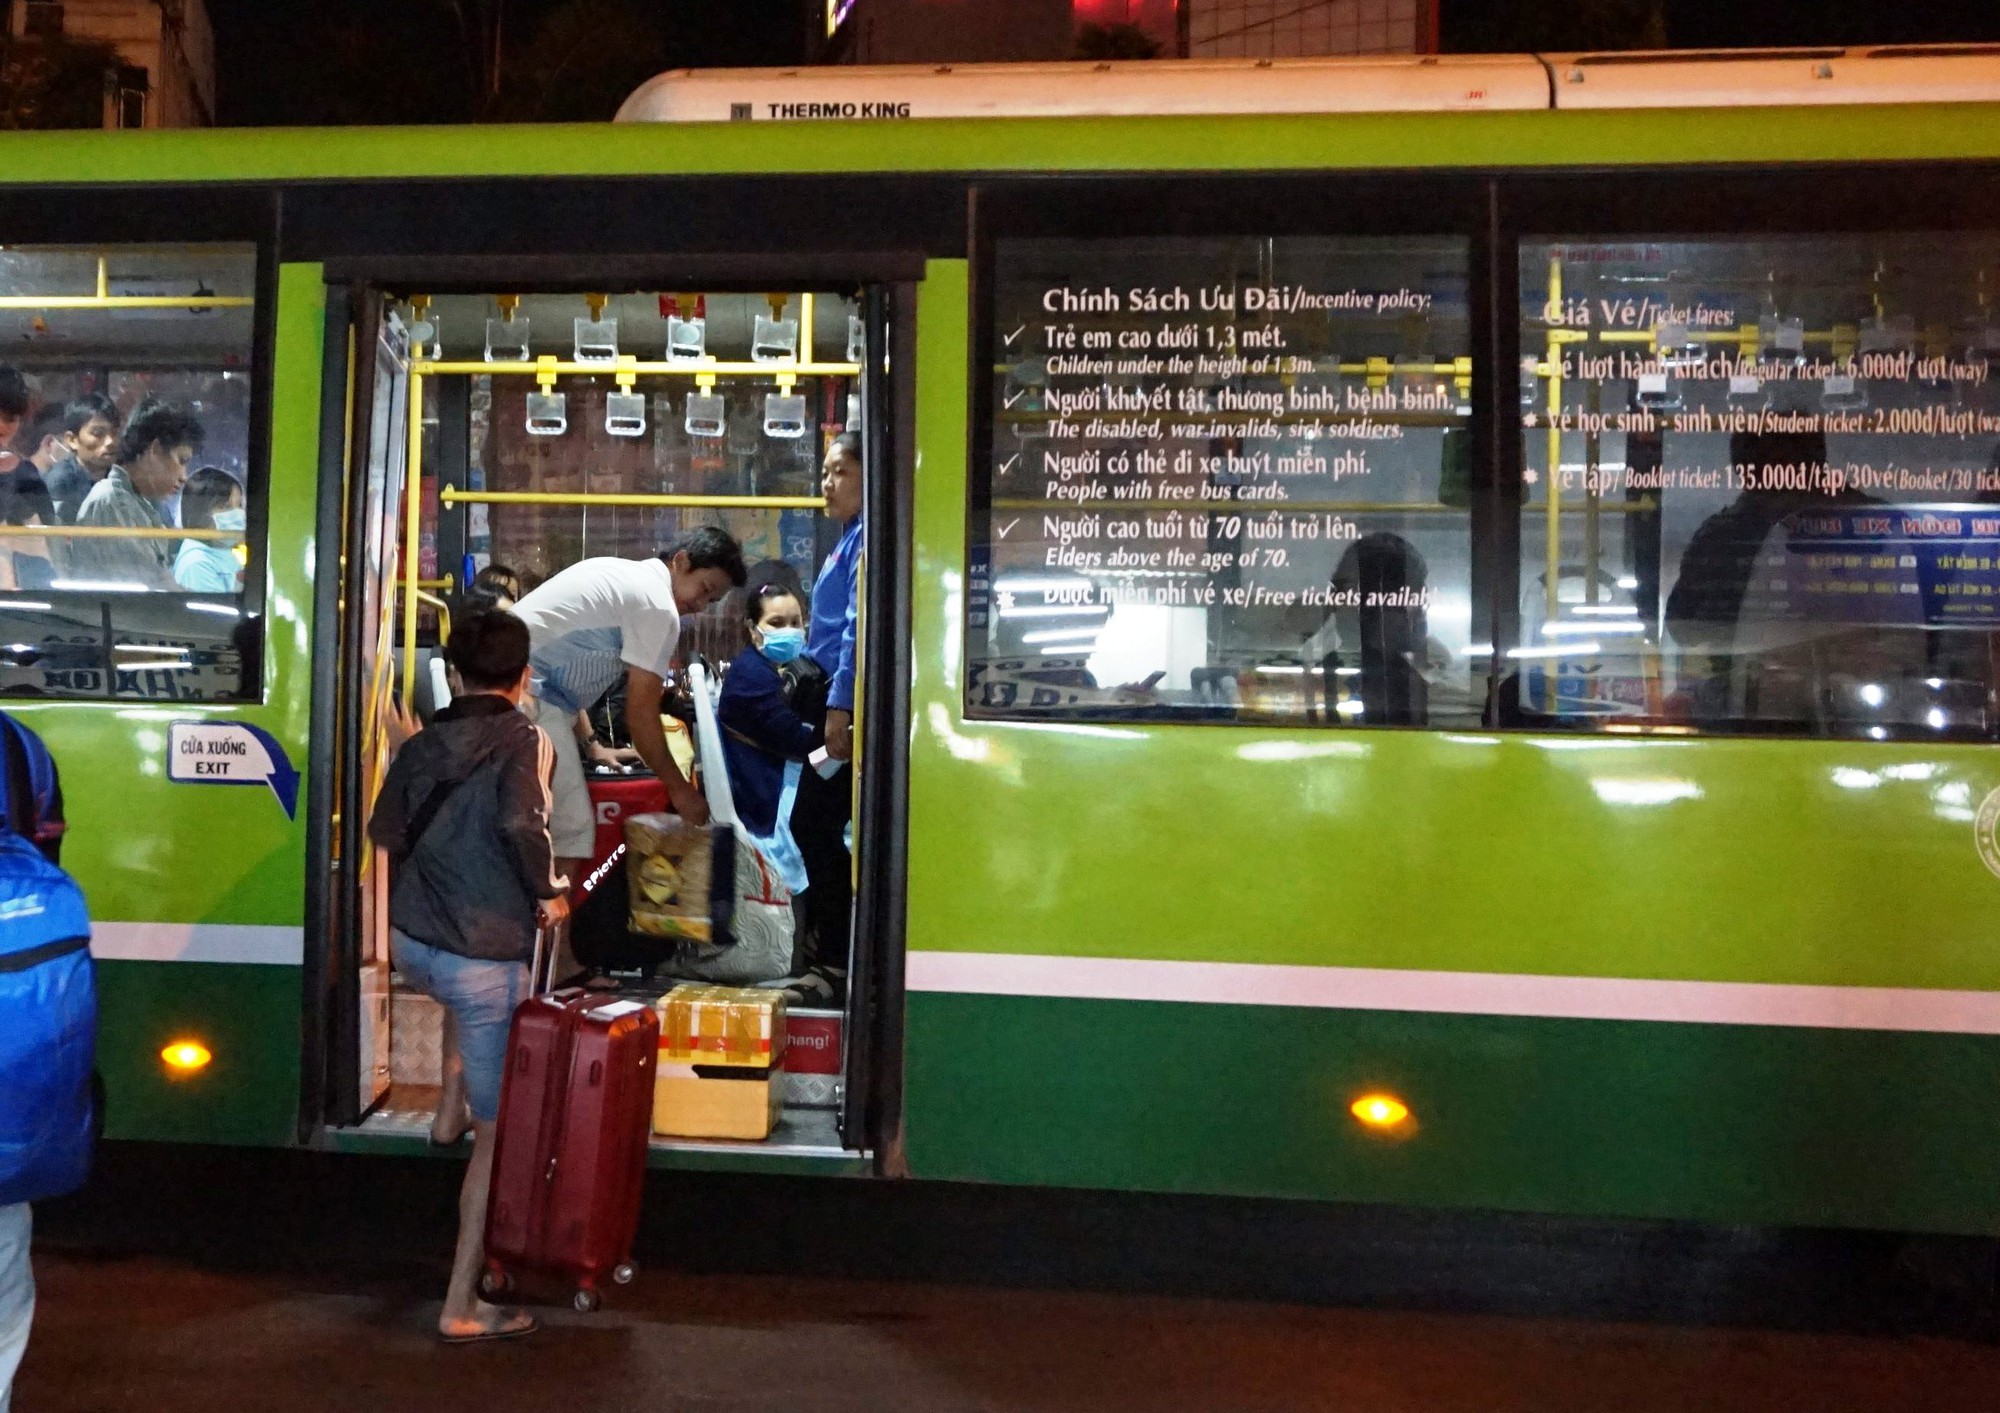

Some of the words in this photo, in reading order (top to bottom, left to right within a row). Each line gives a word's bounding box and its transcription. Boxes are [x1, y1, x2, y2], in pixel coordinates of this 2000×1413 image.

[767, 102, 856, 118] THERMO
[861, 102, 911, 118] KING
[1043, 286, 1120, 312] Chính
[1129, 286, 1190, 312] Sách
[1200, 284, 1234, 311] Ưu
[1044, 323, 1076, 349] Trẻ
[1082, 330, 1112, 348] em
[1118, 330, 1151, 348] cao
[1157, 323, 1198, 348] dưới
[1206, 325, 1236, 352] 1,3
[1242, 323, 1287, 348] mét.
[1046, 353, 1113, 375] Children
[1117, 354, 1164, 374] under
[1168, 354, 1194, 374] the
[1197, 354, 1249, 380] height
[1252, 354, 1270, 374] of
[1274, 355, 1317, 373] 1.3m.
[1578, 351, 1614, 386] lượt
[1620, 351, 1669, 380] hành
[1949, 358, 1989, 388] (way)
[1044, 385, 1101, 418] Người
[1107, 383, 1172, 417] khuyết
[1178, 387, 1210, 416] tật,
[1217, 385, 1284, 418] thương
[1290, 385, 1340, 415] binh,
[1347, 385, 1397, 416] bệnh
[1404, 385, 1455, 410] binh.
[1047, 418, 1080, 438] The
[1085, 418, 1164, 441] disabled,
[1170, 424, 1203, 438] war
[1209, 418, 1283, 440] invalids,
[1289, 418, 1324, 438] sick
[1329, 418, 1404, 439] soldiers.
[1577, 404, 1611, 439] học
[1617, 404, 1655, 433] sinh
[1674, 405, 1712, 432] sinh
[1823, 409, 1864, 433] ticket
[1044, 449, 1100, 481] Người
[1107, 448, 1130, 474] có
[1136, 448, 1167, 474] thẻ
[1173, 449, 1192, 474] đi
[1200, 456, 1222, 474] xe
[1227, 449, 1271, 481] buýt
[1277, 446, 1327, 474] miễn
[1333, 449, 1372, 482] phí.
[1625, 464, 1676, 489] Booklet
[1045, 480, 1108, 505] People
[1113, 480, 1152, 500] with
[1157, 480, 1195, 501] free
[1201, 480, 1231, 500] bus
[1237, 480, 1289, 501] cards.
[1043, 514, 1100, 545] Người
[1107, 521, 1140, 539] cao
[1146, 509, 1183, 539] tuổi
[1189, 514, 1210, 539] từ
[1215, 515, 1242, 539] 70
[1247, 509, 1284, 539] tuổi
[1290, 513, 1320, 539] trở
[1326, 514, 1363, 539] lên.
[1045, 546, 1102, 567] Elders
[1107, 546, 1161, 567] above
[1167, 546, 1196, 567] the
[1201, 552, 1233, 573] age
[1238, 547, 1259, 567] of
[1263, 548, 1290, 568] 70.
[1155, 580, 1187, 610] phí
[1193, 580, 1216, 605] vé
[1302, 586, 1361, 606] tickets
[181, 734, 204, 754] CỬA
[207, 735, 247, 756] XUỐNG
[195, 762, 231, 775] EXIT
